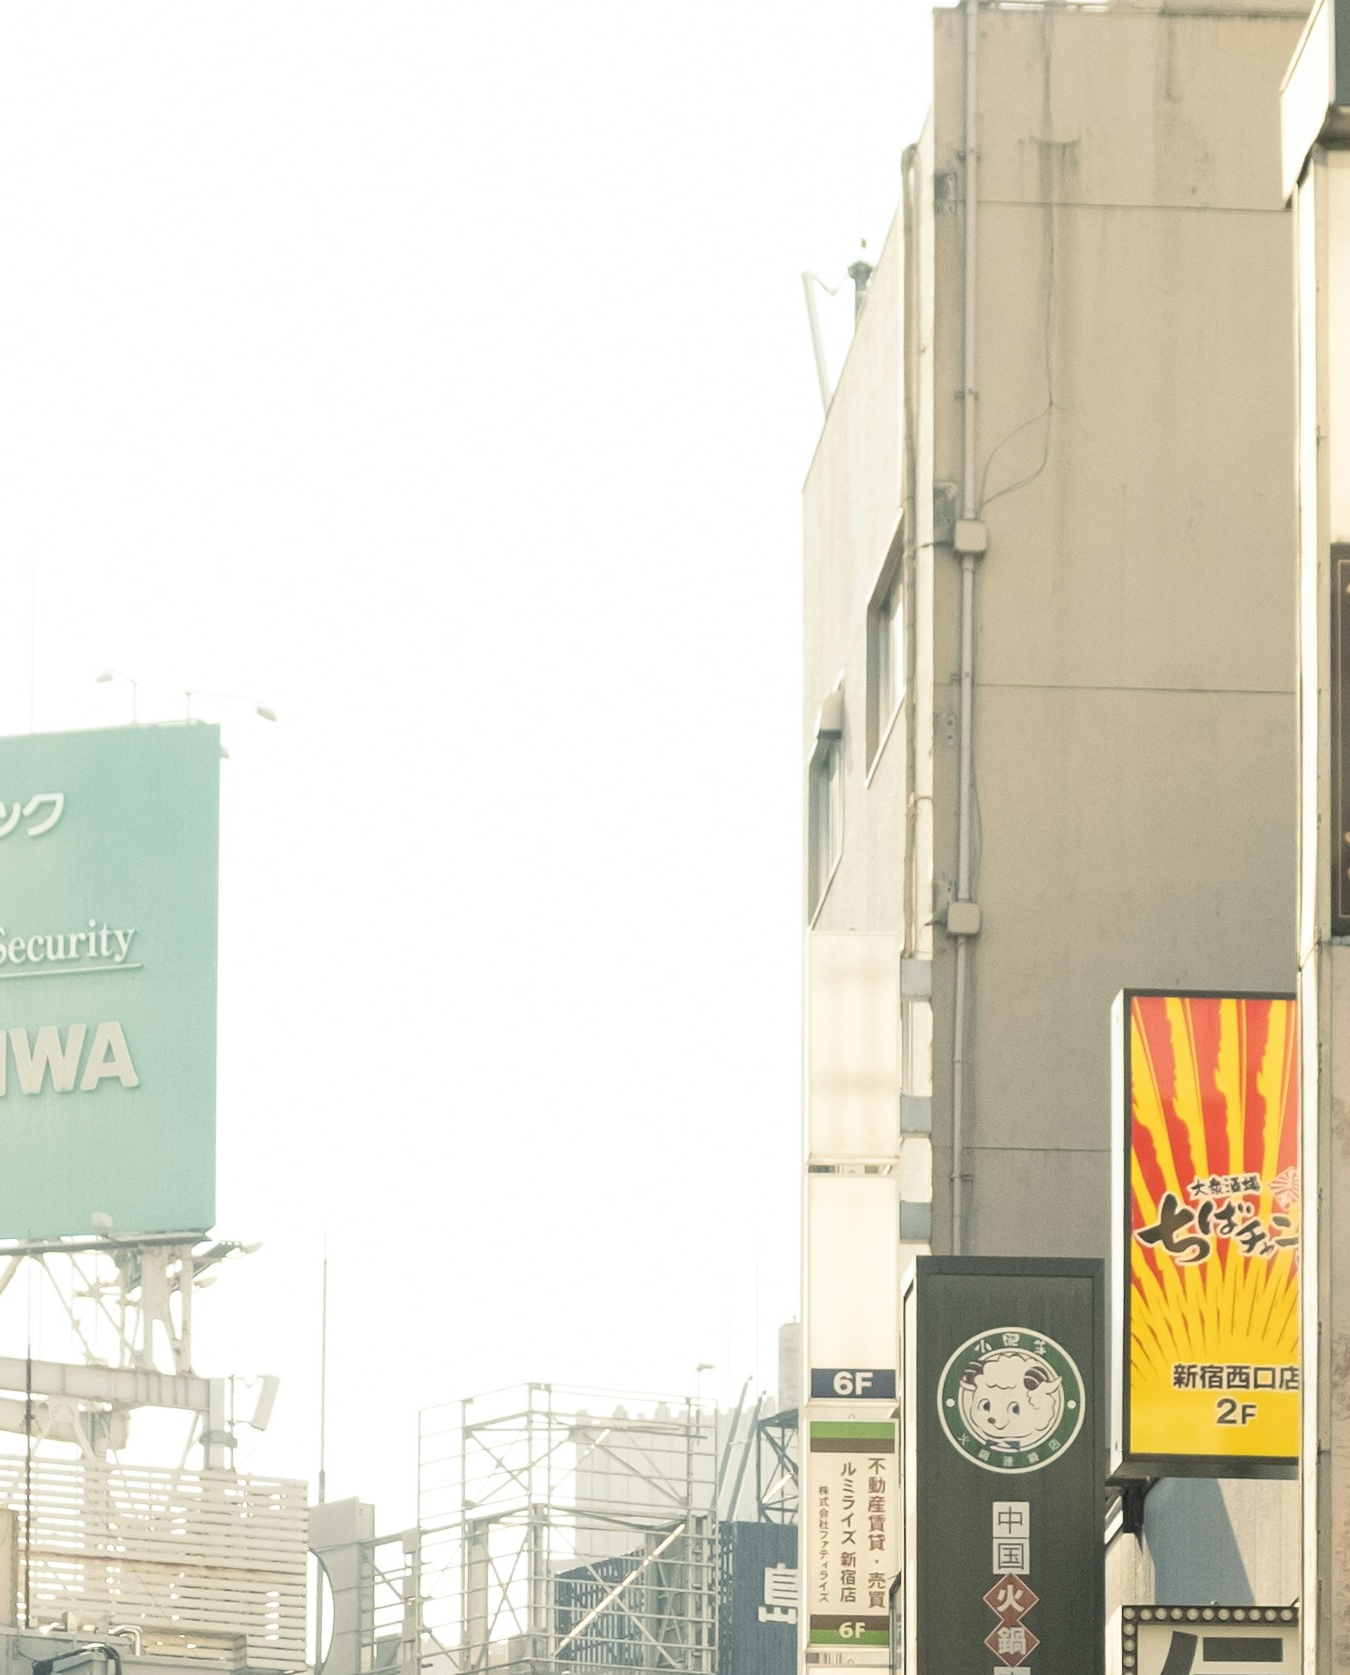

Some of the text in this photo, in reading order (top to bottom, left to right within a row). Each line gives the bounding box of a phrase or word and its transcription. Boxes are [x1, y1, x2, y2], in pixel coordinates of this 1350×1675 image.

[832, 1370, 874, 1396] 6F
[1173, 1364, 1301, 1391] 新宿西口店
[1216, 1398, 1257, 1424] 2F
[839, 1461, 857, 1604] ルミライズ 新宿店
[867, 1456, 887, 1610] 不動産賃貸・売買
[837, 1621, 867, 1640] 6F
